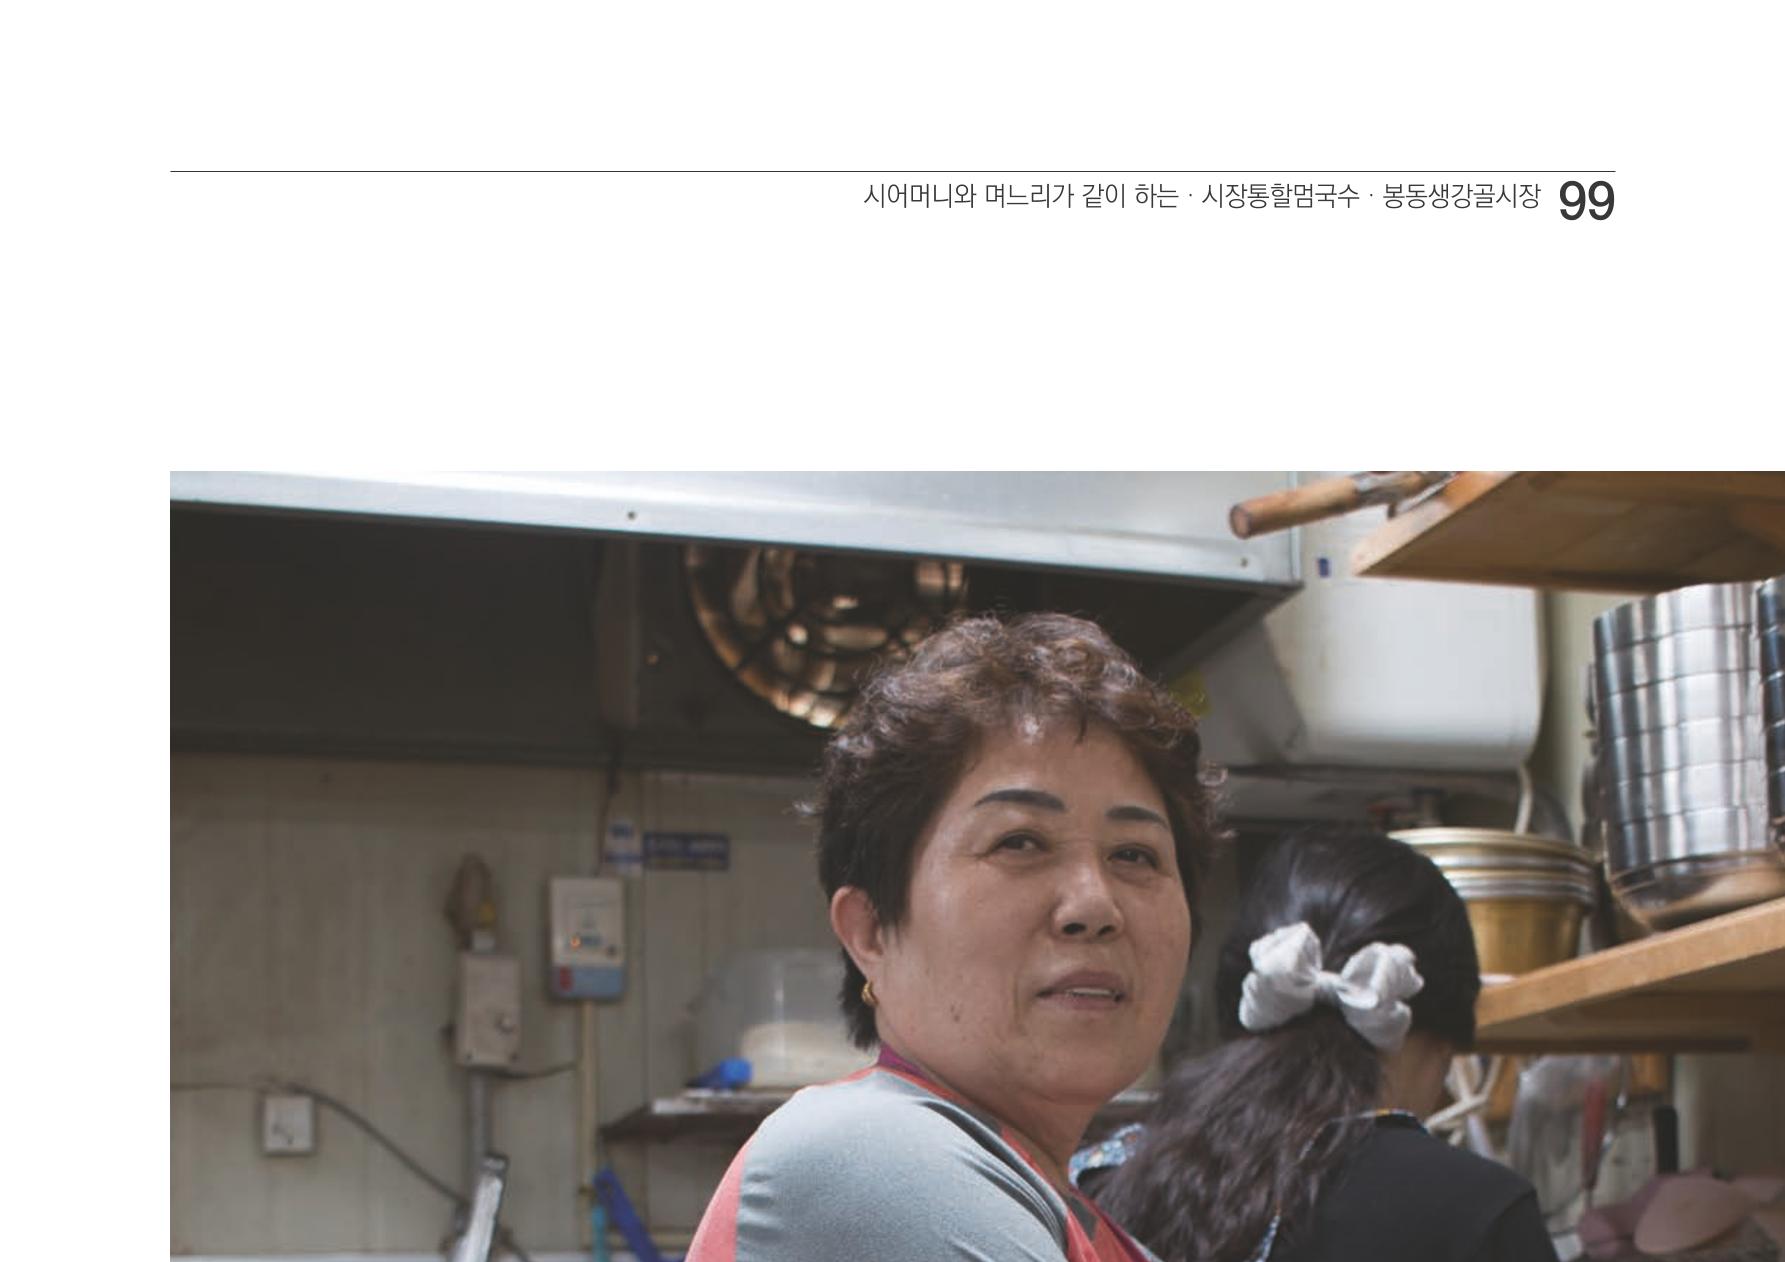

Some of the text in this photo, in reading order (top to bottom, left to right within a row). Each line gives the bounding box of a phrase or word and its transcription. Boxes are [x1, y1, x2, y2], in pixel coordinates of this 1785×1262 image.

[863, 183, 1542, 209] 시어머니와 며느리가 같이 하는 시장통할멈국수 봉동생강골시장
[1559, 180, 1615, 221] 99
